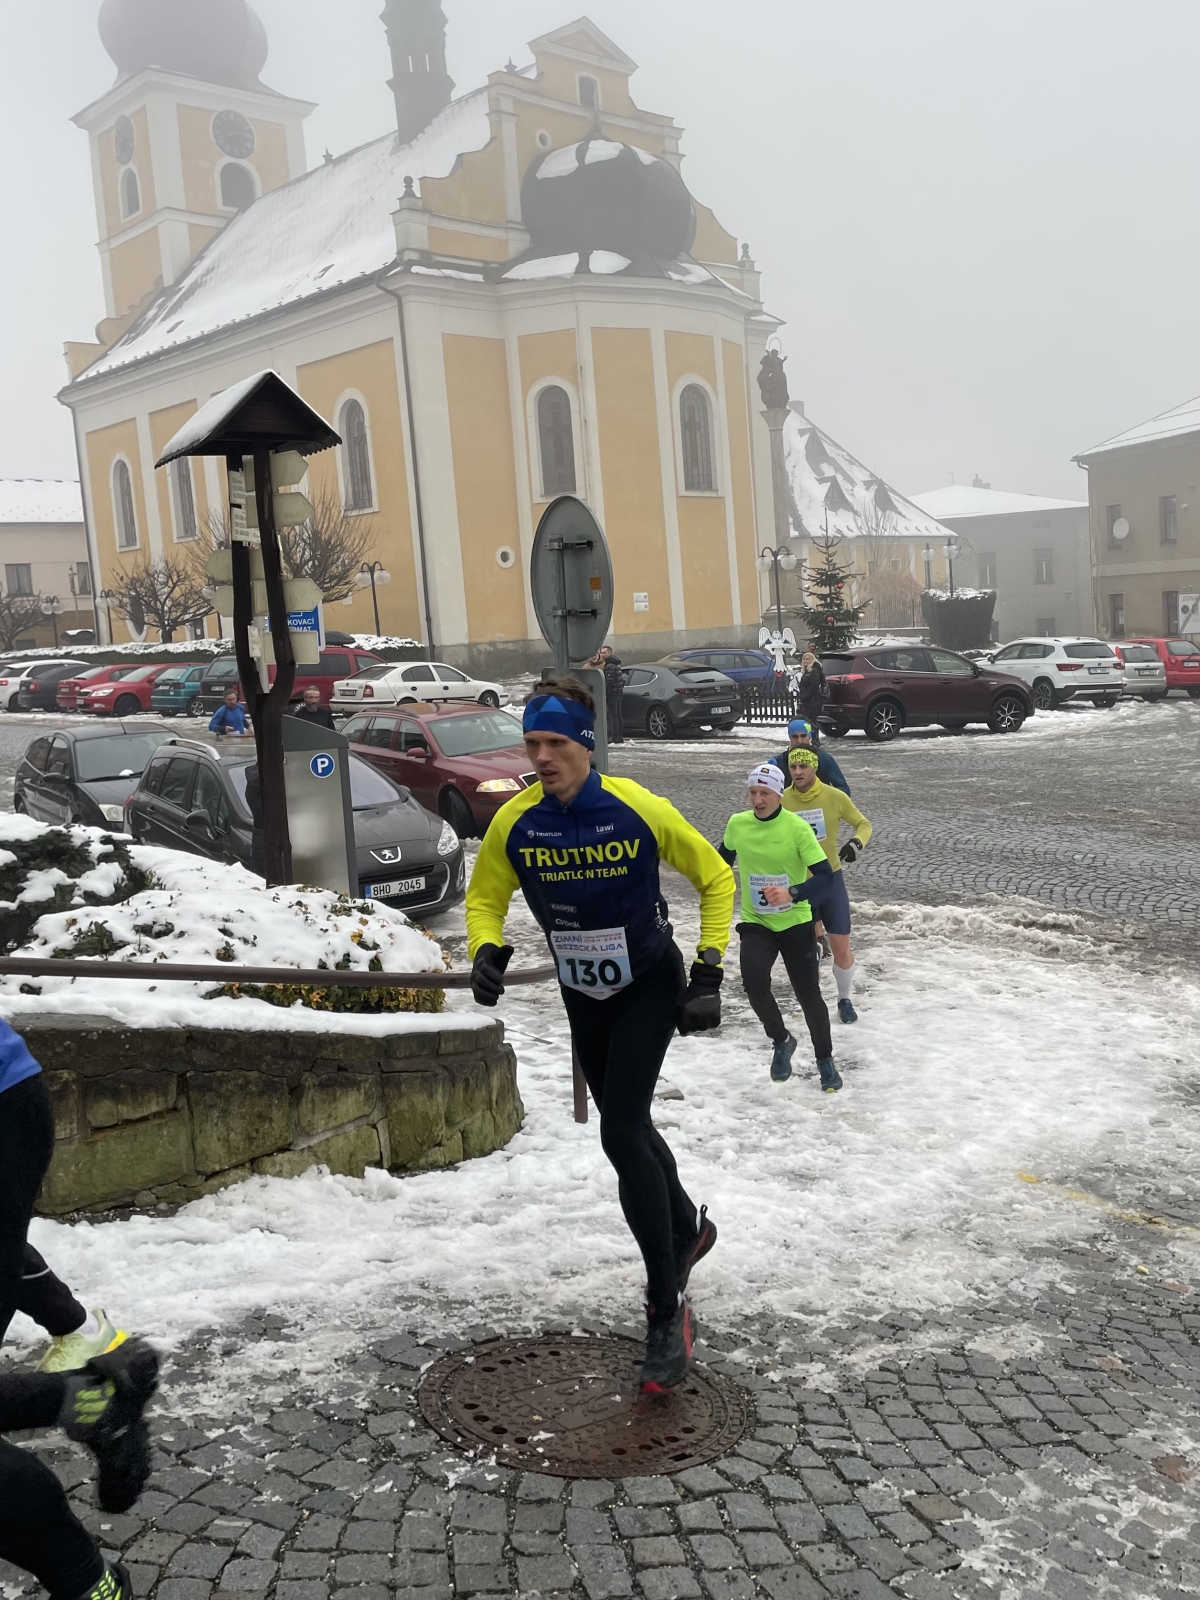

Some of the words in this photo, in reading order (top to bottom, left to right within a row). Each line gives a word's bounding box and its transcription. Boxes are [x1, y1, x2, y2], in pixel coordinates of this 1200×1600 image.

[287, 617, 315, 626] KOVACÍ
[316, 757, 329, 774] P
[519, 839, 640, 867] TRUTNOV
[595, 865, 628, 879] TEAM
[397, 878, 421, 892] 2045
[757, 890, 769, 907] 3
[600, 942, 625, 952] LIGA
[565, 957, 622, 987] 130
